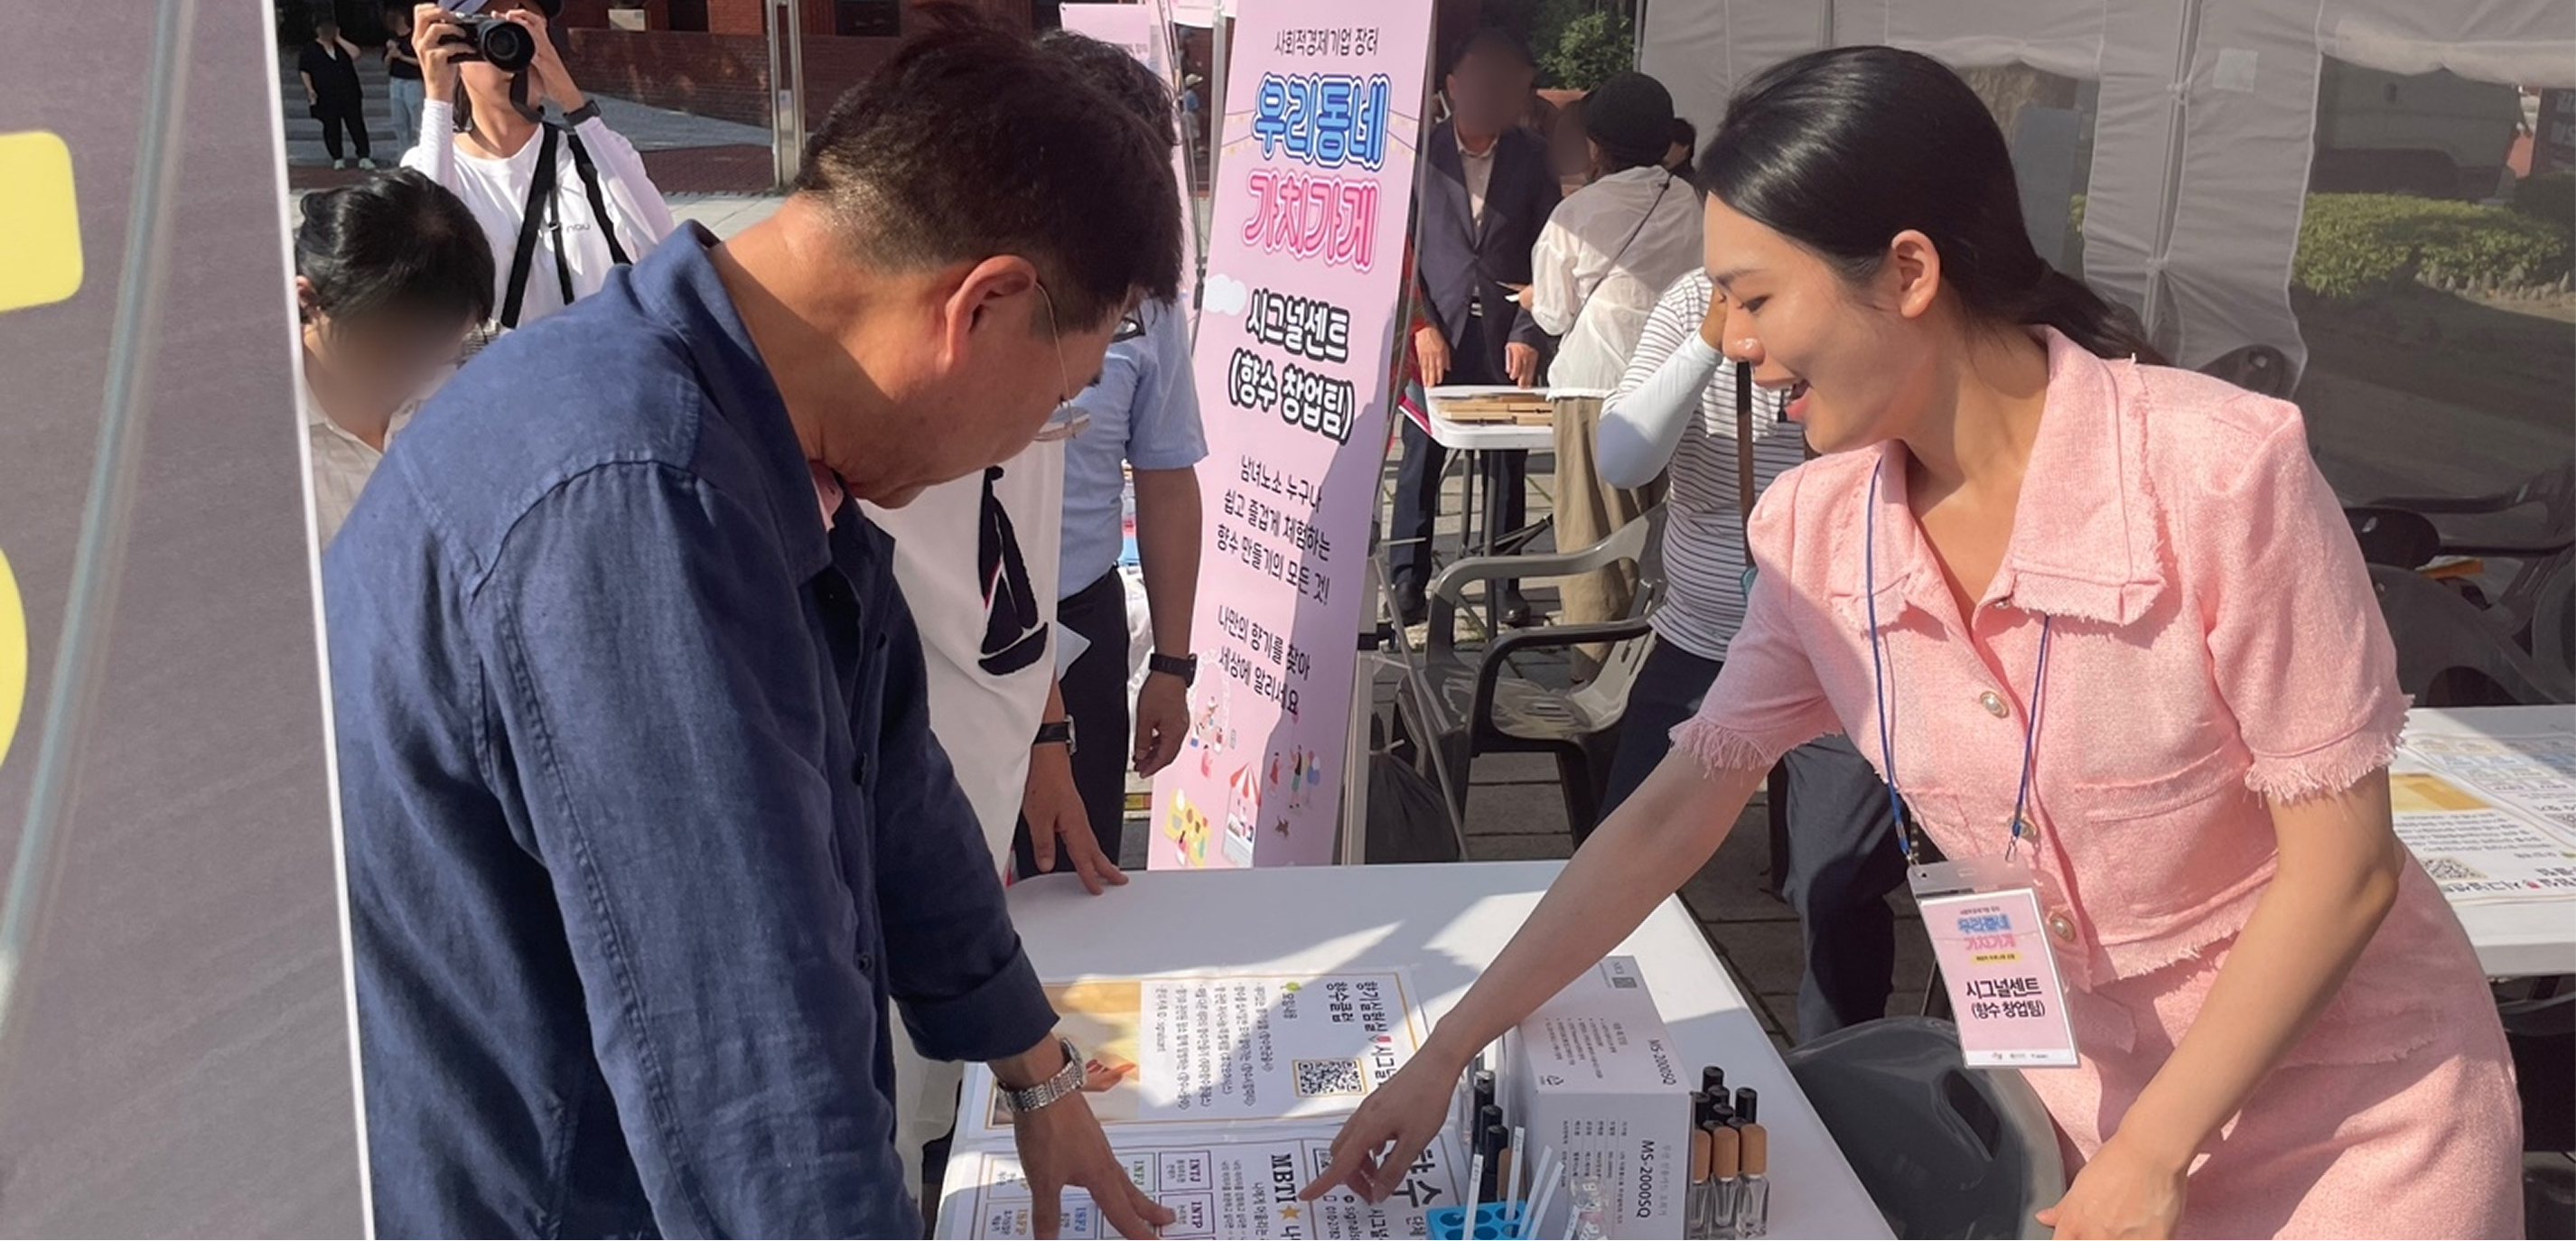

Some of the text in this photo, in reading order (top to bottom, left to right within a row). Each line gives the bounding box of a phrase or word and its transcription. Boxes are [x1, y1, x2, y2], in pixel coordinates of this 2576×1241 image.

[1274, 27, 1378, 56] 사회적경제기업 장터
[1253, 72, 1391, 172] 우리동네
[1243, 168, 1381, 273] 가치가게
[1246, 288, 1349, 363] 시그널센트
[1229, 348, 1355, 446] (향수 창업팀)
[1241, 454, 1321, 513] 남녀노소 누구나
[1224, 489, 1330, 562] 쉽고 즐겁게 체험하는
[1218, 523, 1330, 606] 향수 만들기의 모든 것!
[1218, 604, 1311, 681] 나만의 향기를 찾아
[1218, 646, 1299, 715] 세상에 알리세요
[1326, 982, 1355, 1023] 향수클럽
[1966, 977, 2042, 999] 시그널센트
[1971, 1000, 2046, 1020] (향수 창업팀)
[1356, 981, 1397, 1083] 향기실험실 시그널
[1647, 1039, 1677, 1086] MS-2000SQ
[1134, 1160, 1145, 1186] INFJ
[1190, 1159, 1200, 1182] INTJ
[1271, 1153, 1297, 1204] MBTI
[1636, 1140, 1655, 1218] MS-2000SQ
[1015, 1208, 1029, 1236] ISFP
[1075, 1207, 1087, 1232] ISFJ
[1190, 1201, 1203, 1228] INTP
[1367, 1208, 1389, 1241] 시그널
